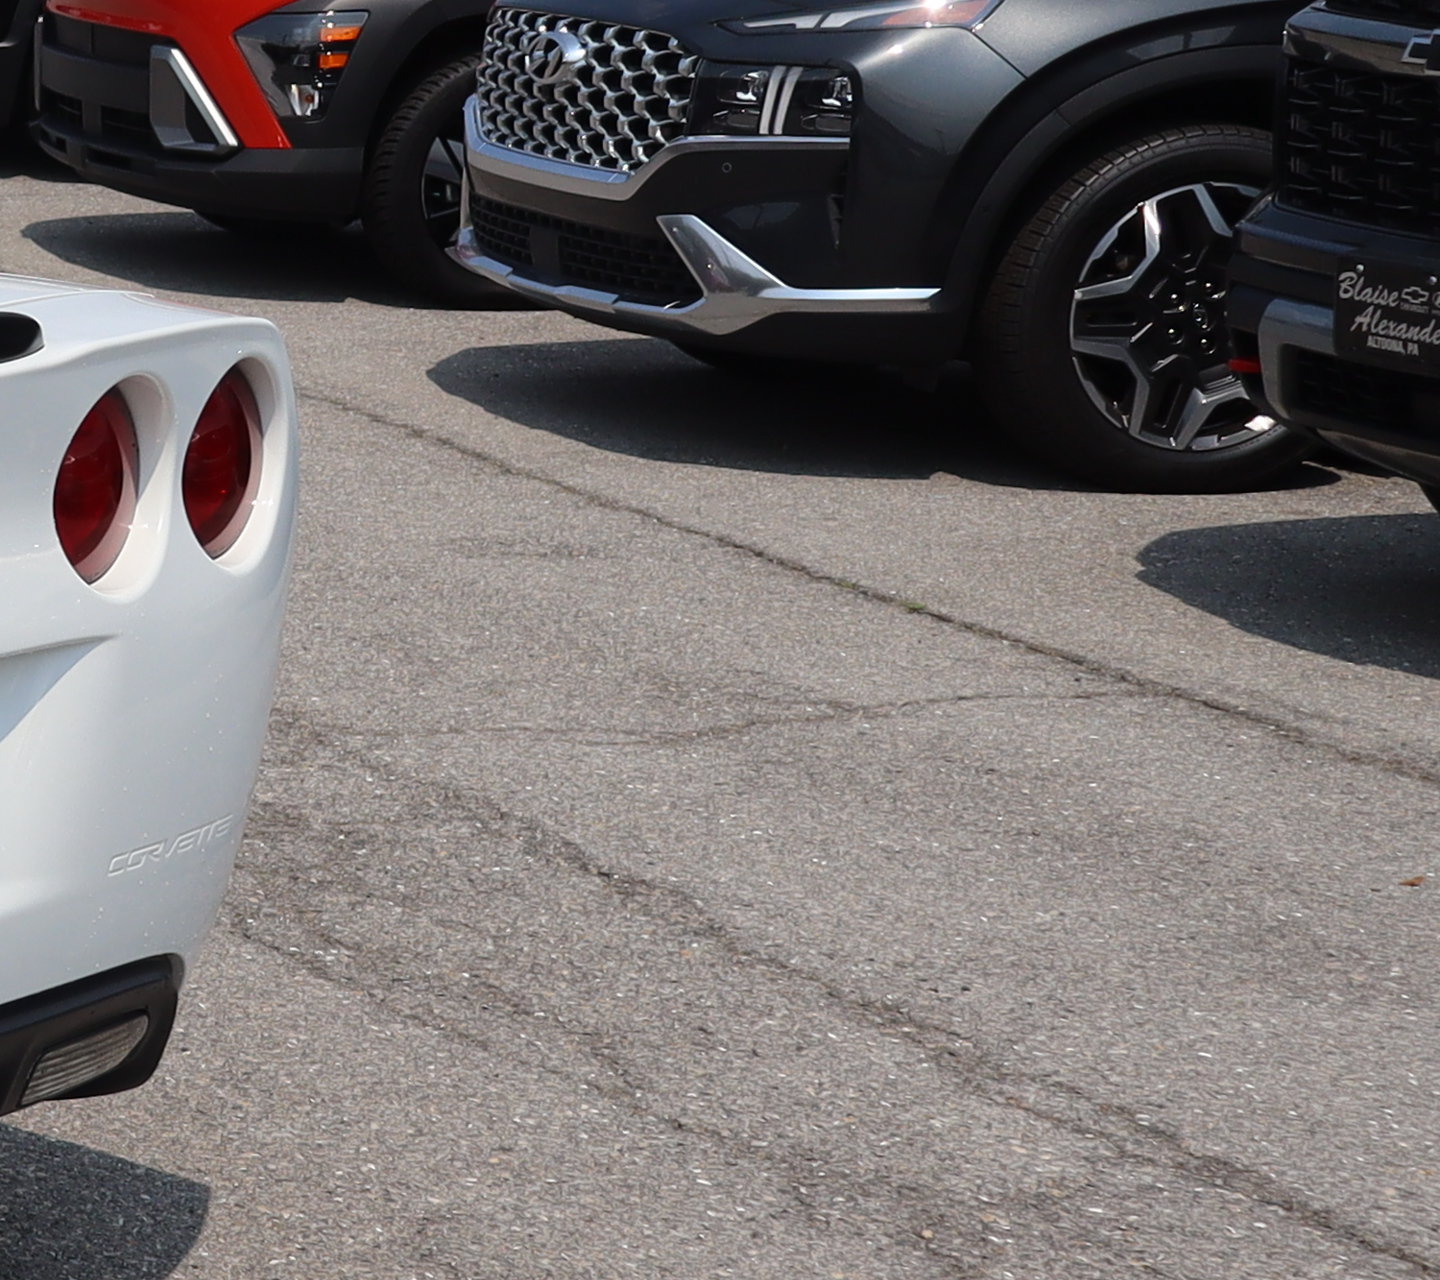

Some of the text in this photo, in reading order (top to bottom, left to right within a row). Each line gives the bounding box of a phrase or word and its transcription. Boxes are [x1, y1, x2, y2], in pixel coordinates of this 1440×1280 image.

[1338, 271, 1400, 308] Blaise
[1407, 342, 1420, 356] PA
[107, 813, 234, 877] CORVETTE
